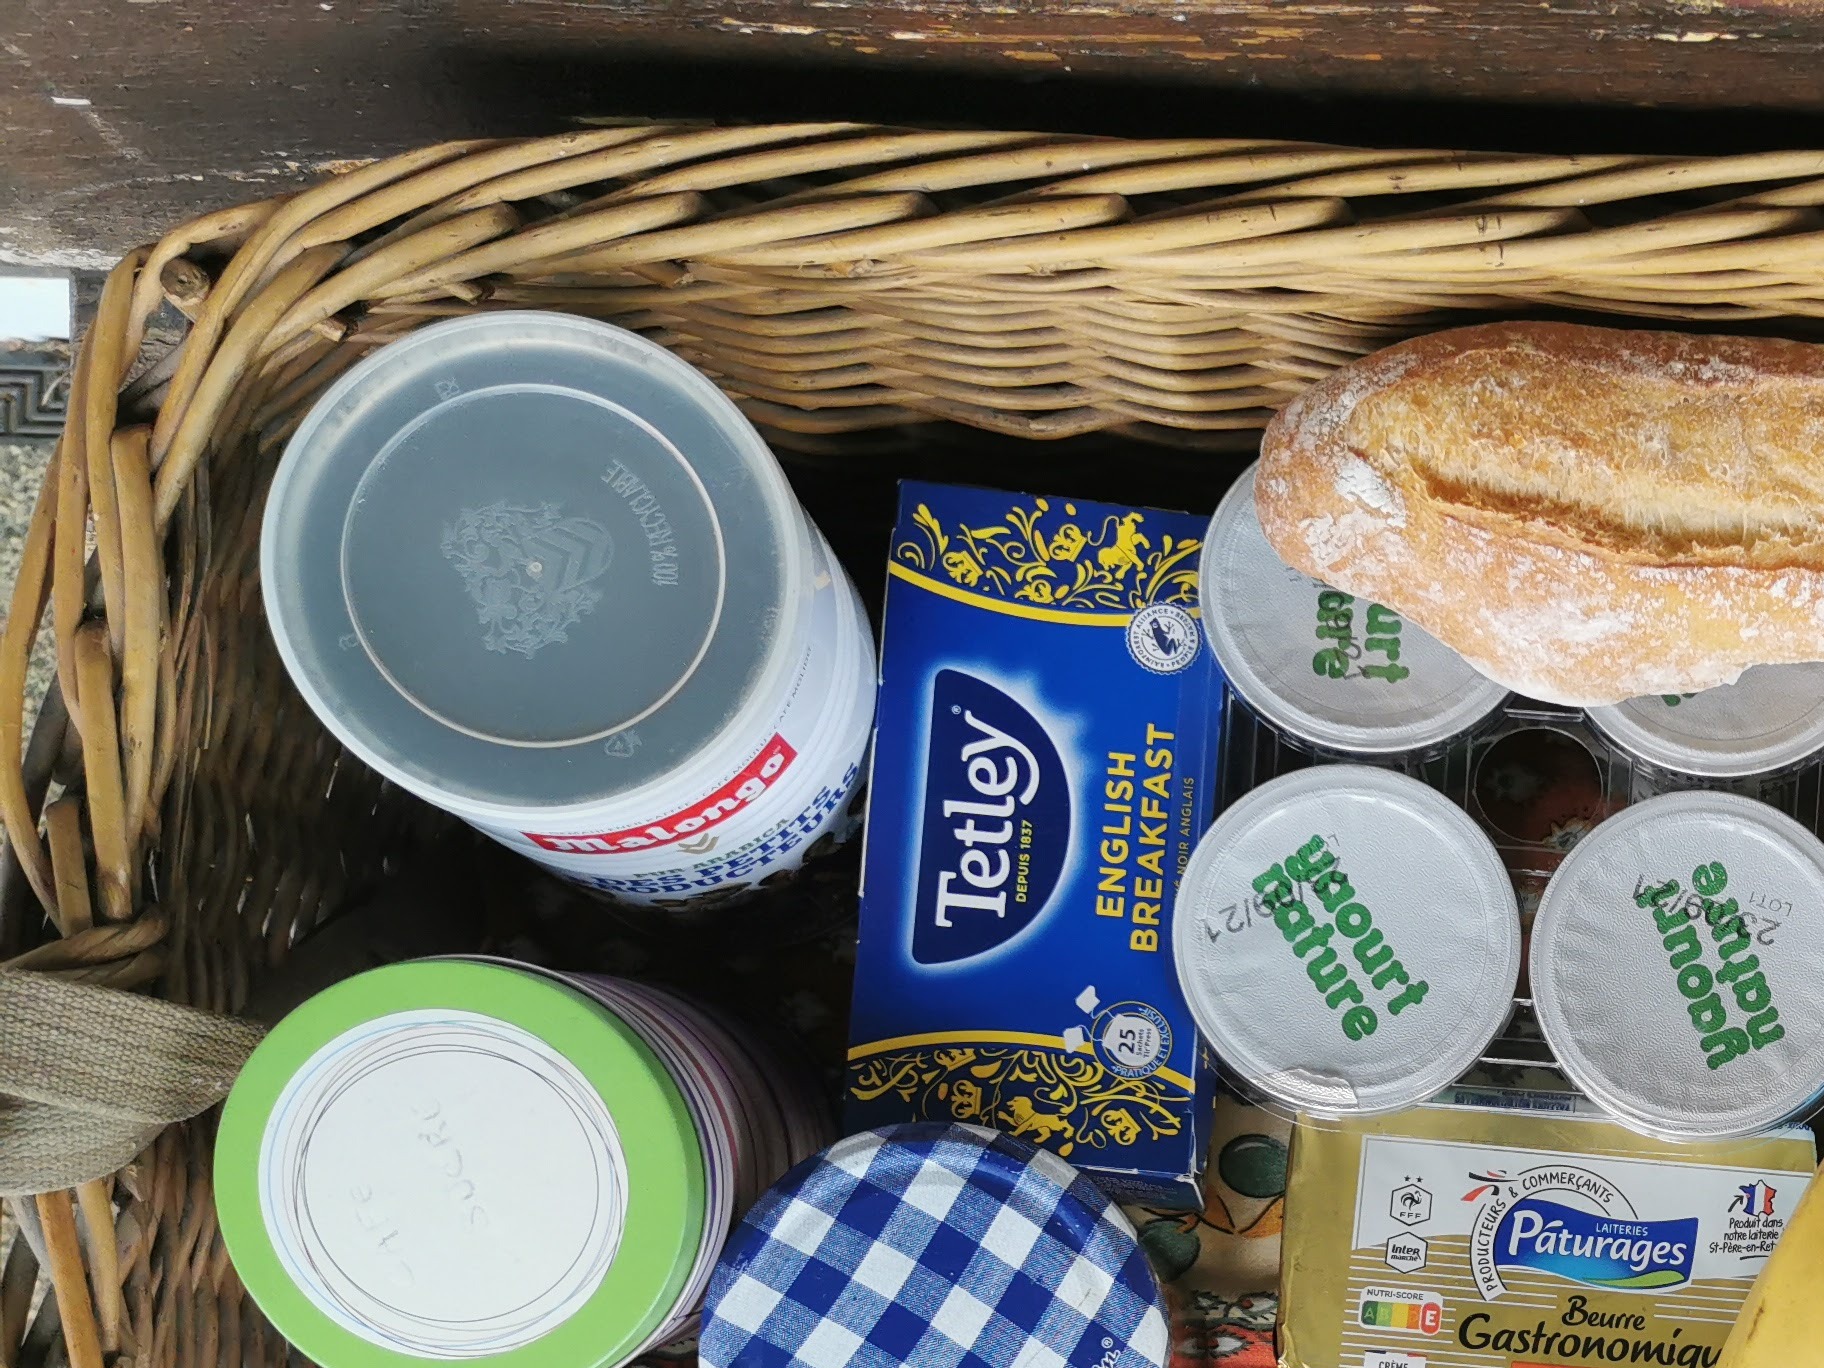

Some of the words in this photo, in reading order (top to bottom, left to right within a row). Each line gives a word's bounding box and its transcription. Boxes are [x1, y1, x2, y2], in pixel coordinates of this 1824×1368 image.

[601, 459, 674, 546] RECYCLABLE
[1365, 603, 1410, 684] urt
[543, 753, 785, 851] Malongo
[695, 785, 832, 878] PETITS
[935, 709, 1040, 928] Tetley
[1019, 819, 1033, 849] 1837
[1095, 751, 1136, 918] ENGLISH
[1129, 722, 1175, 952] BREAKFAST
[1180, 777, 1194, 837] ANGLAIS
[1015, 852, 1031, 903] DEPUIS
[1252, 862, 1378, 1042] nature
[1284, 834, 1430, 1016] yaourt
[1692, 861, 1786, 1051] nature
[1636, 878, 1751, 1071] yaourt
[1112, 1058, 1162, 1078] PRATIQUE
[1118, 1029, 1135, 1054] 25
[1400, 1211, 1422, 1220] FFF
[1477, 1198, 1507, 1292] PRODUCTEURS
[1508, 1187, 1519, 1199] &
[1522, 1172, 1614, 1203] COMMERÇANTS
[1596, 1222, 1649, 1236] LAITERIES
[1709, 1241, 1777, 1253] St-Père-en-Ret
[1729, 1217, 1761, 1229] Produit
[1762, 1217, 1783, 1228] dans
[1364, 1308, 1375, 1319] A
[1425, 1310, 1437, 1326] E
[1367, 1289, 1424, 1300] NUTRI-SCORE
[1561, 1294, 1646, 1331] Beurre
